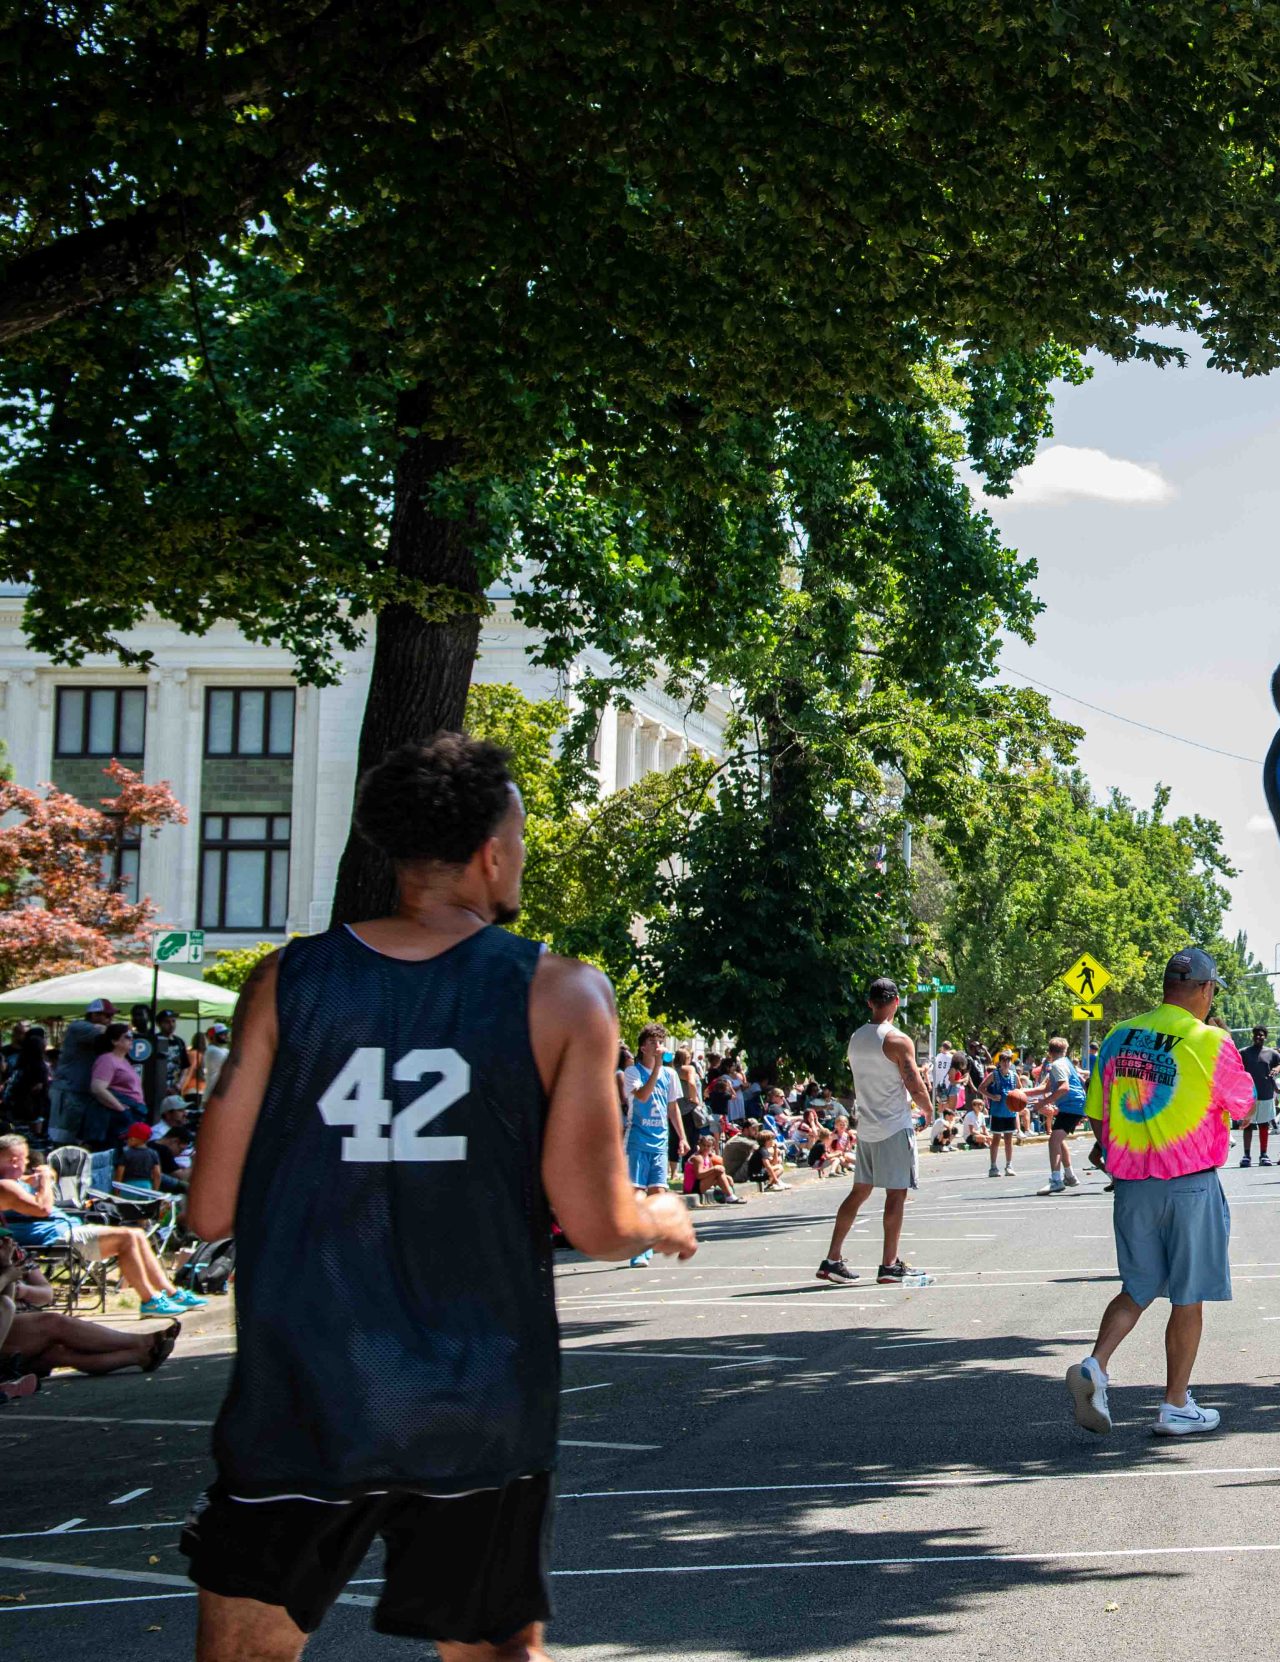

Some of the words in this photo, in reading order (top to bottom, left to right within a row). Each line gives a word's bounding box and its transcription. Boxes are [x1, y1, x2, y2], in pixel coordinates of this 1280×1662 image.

[1121, 1029, 1184, 1052] F&W
[1118, 1047, 1155, 1061] FENCE
[1115, 1067, 1126, 1078] YOU
[1127, 1068, 1144, 1080] MAKE
[1145, 1071, 1158, 1083] THE
[1158, 1073, 1175, 1087] CALL
[316, 1047, 471, 1162] 42
